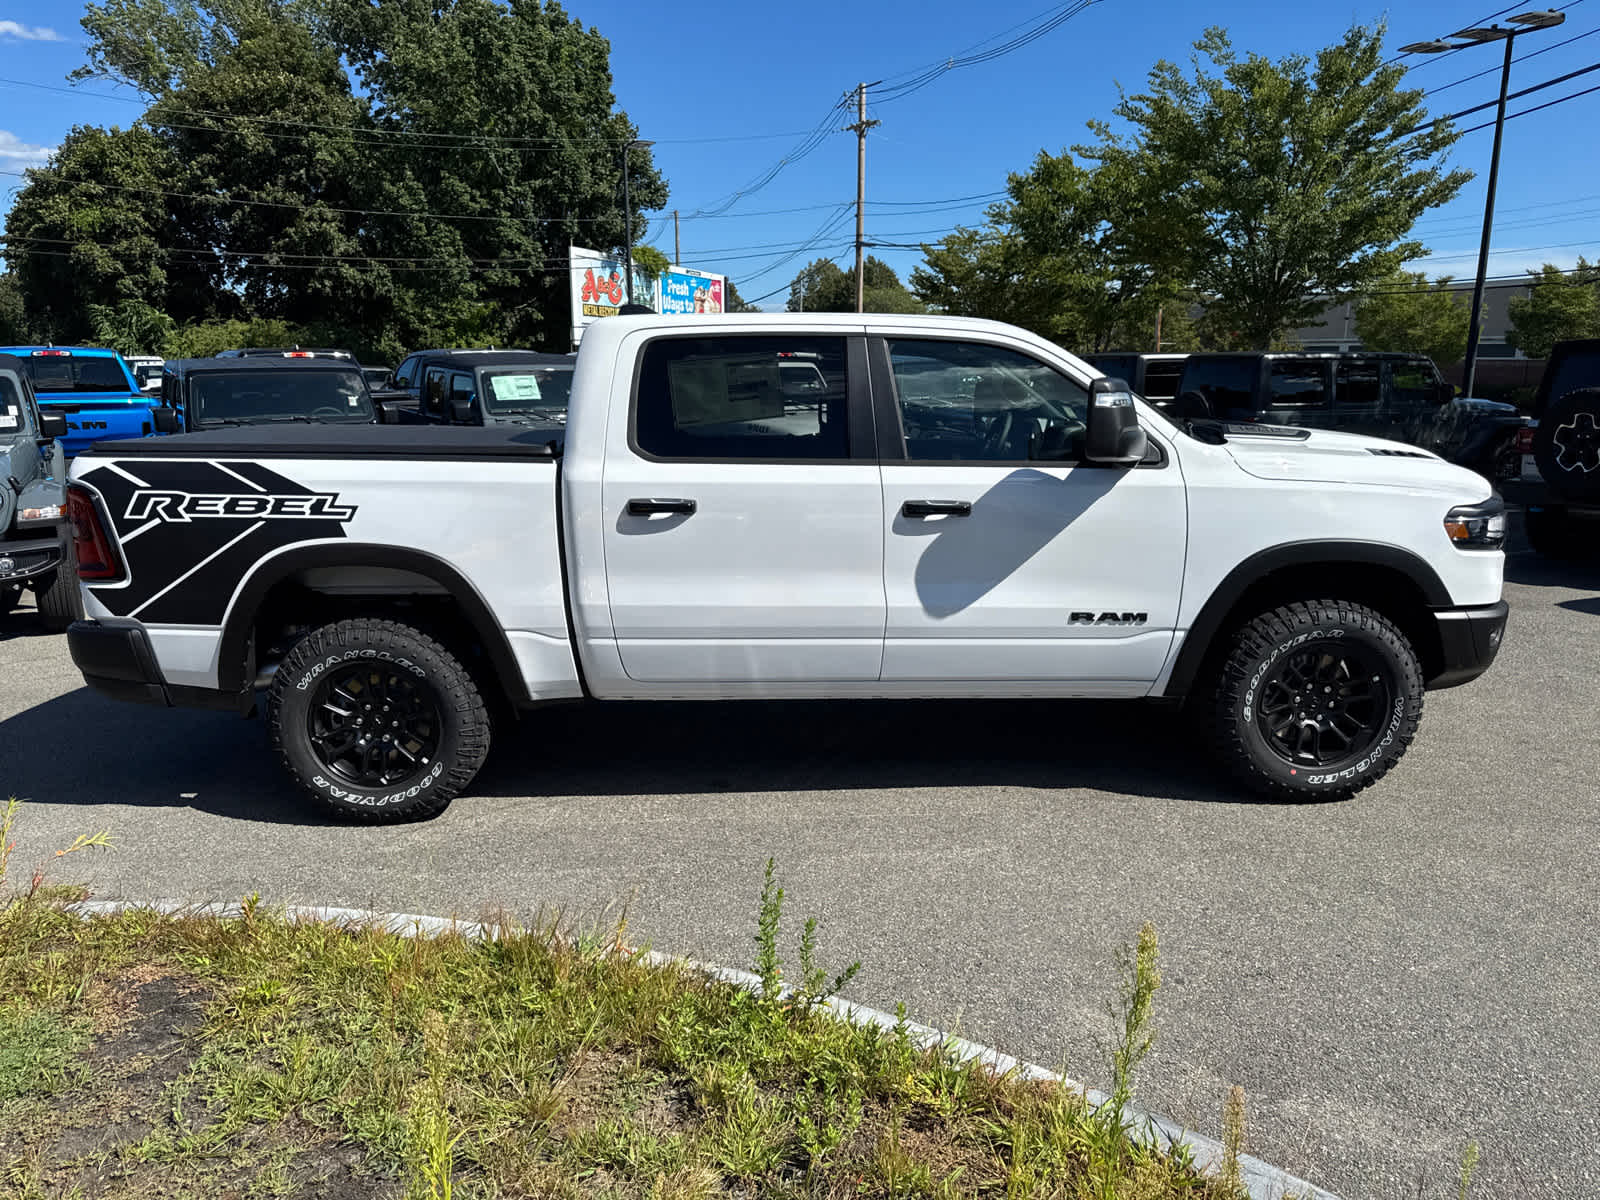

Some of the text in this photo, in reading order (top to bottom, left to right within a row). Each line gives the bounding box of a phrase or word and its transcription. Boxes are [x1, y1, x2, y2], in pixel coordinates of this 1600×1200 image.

[663, 294, 694, 313] Ways to
[667, 279, 689, 296] Fresh
[124, 490, 359, 522] REBEL
[1067, 611, 1148, 626] RAM
[296, 649, 426, 691] WRANGLER
[1244, 629, 1345, 722] GOODYEAR
[1307, 696, 1405, 784] WRANGLER
[312, 761, 444, 806] GOODYEAR
